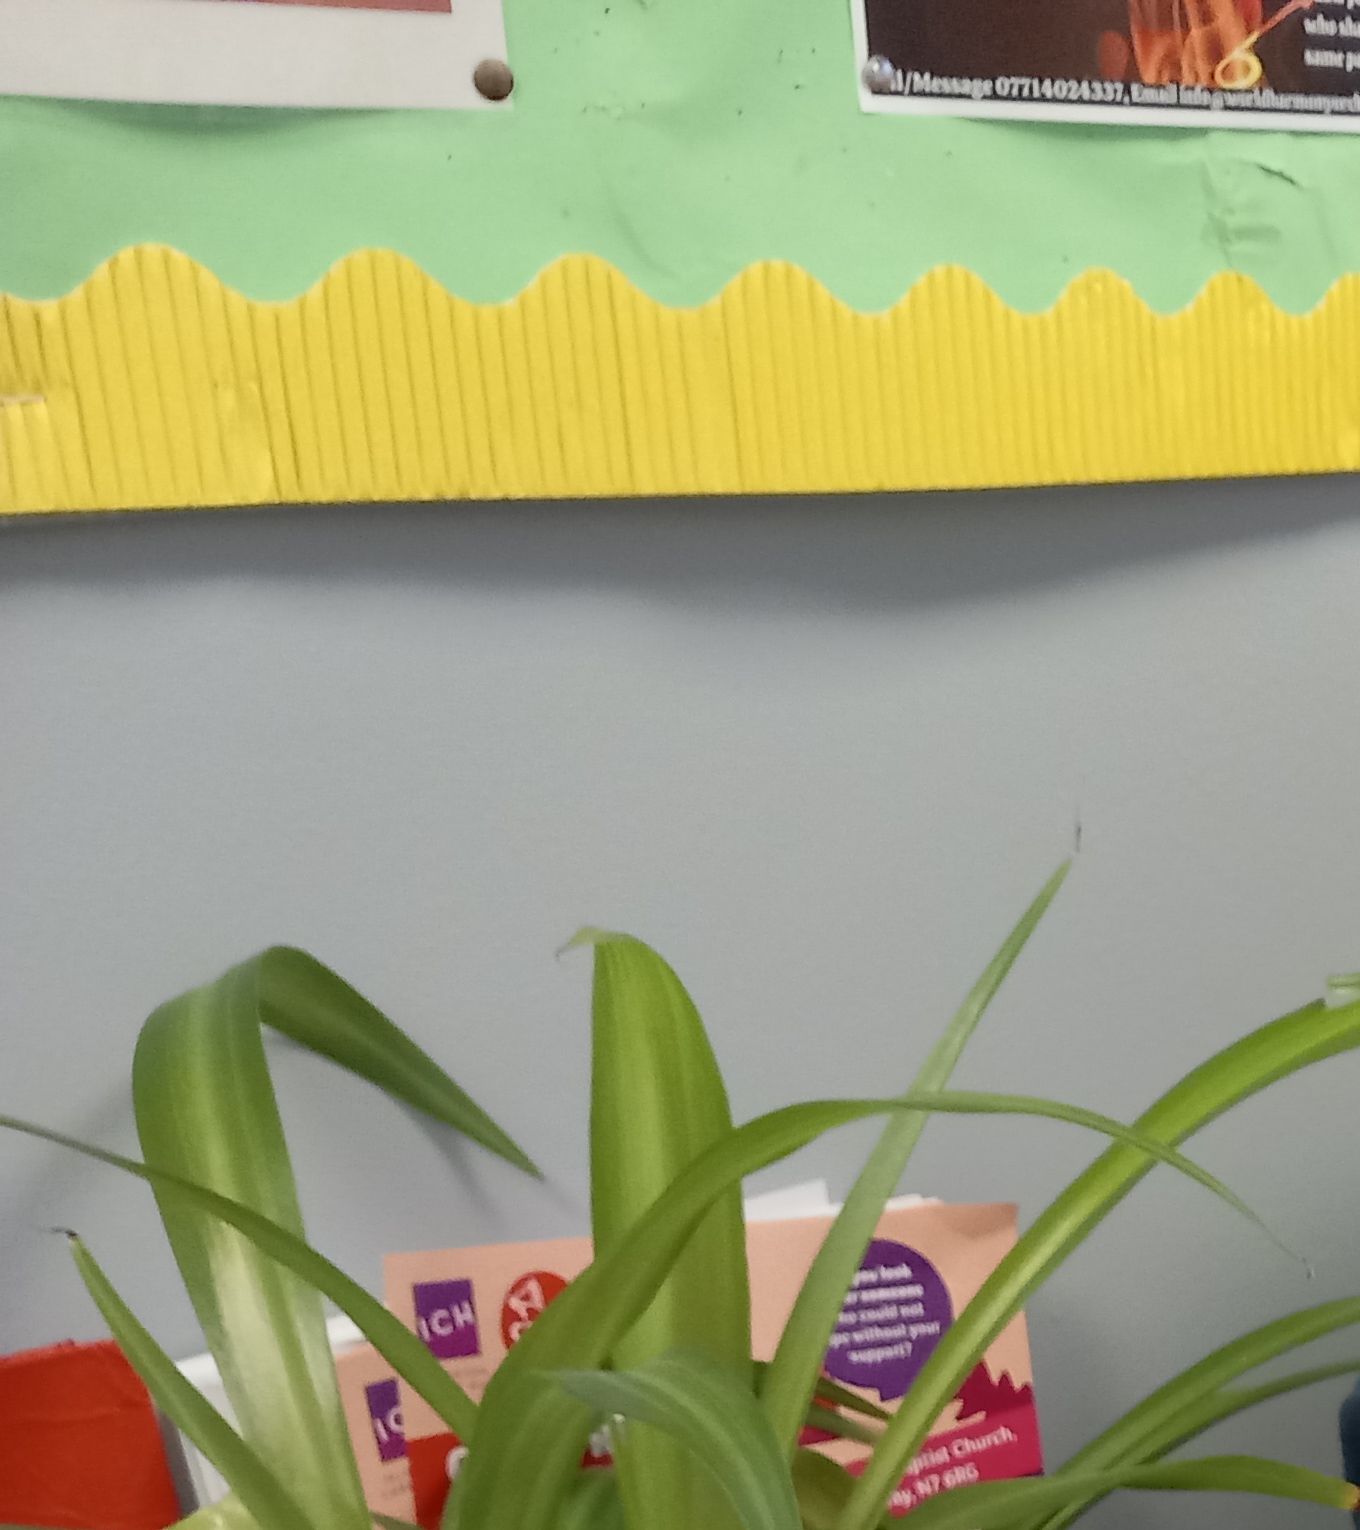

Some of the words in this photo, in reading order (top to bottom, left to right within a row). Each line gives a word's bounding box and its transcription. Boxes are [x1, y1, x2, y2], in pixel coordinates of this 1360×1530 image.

[1303, 12, 1338, 37] who
[1303, 48, 1345, 69] same
[880, 1262, 913, 1281] look
[858, 1281, 925, 1302] someone
[859, 1302, 899, 1323] could
[900, 1298, 926, 1319] not
[851, 1320, 907, 1344] without
[907, 1320, 941, 1341] your
[846, 1340, 913, 1365] support?
[371, 1403, 406, 1444] IC
